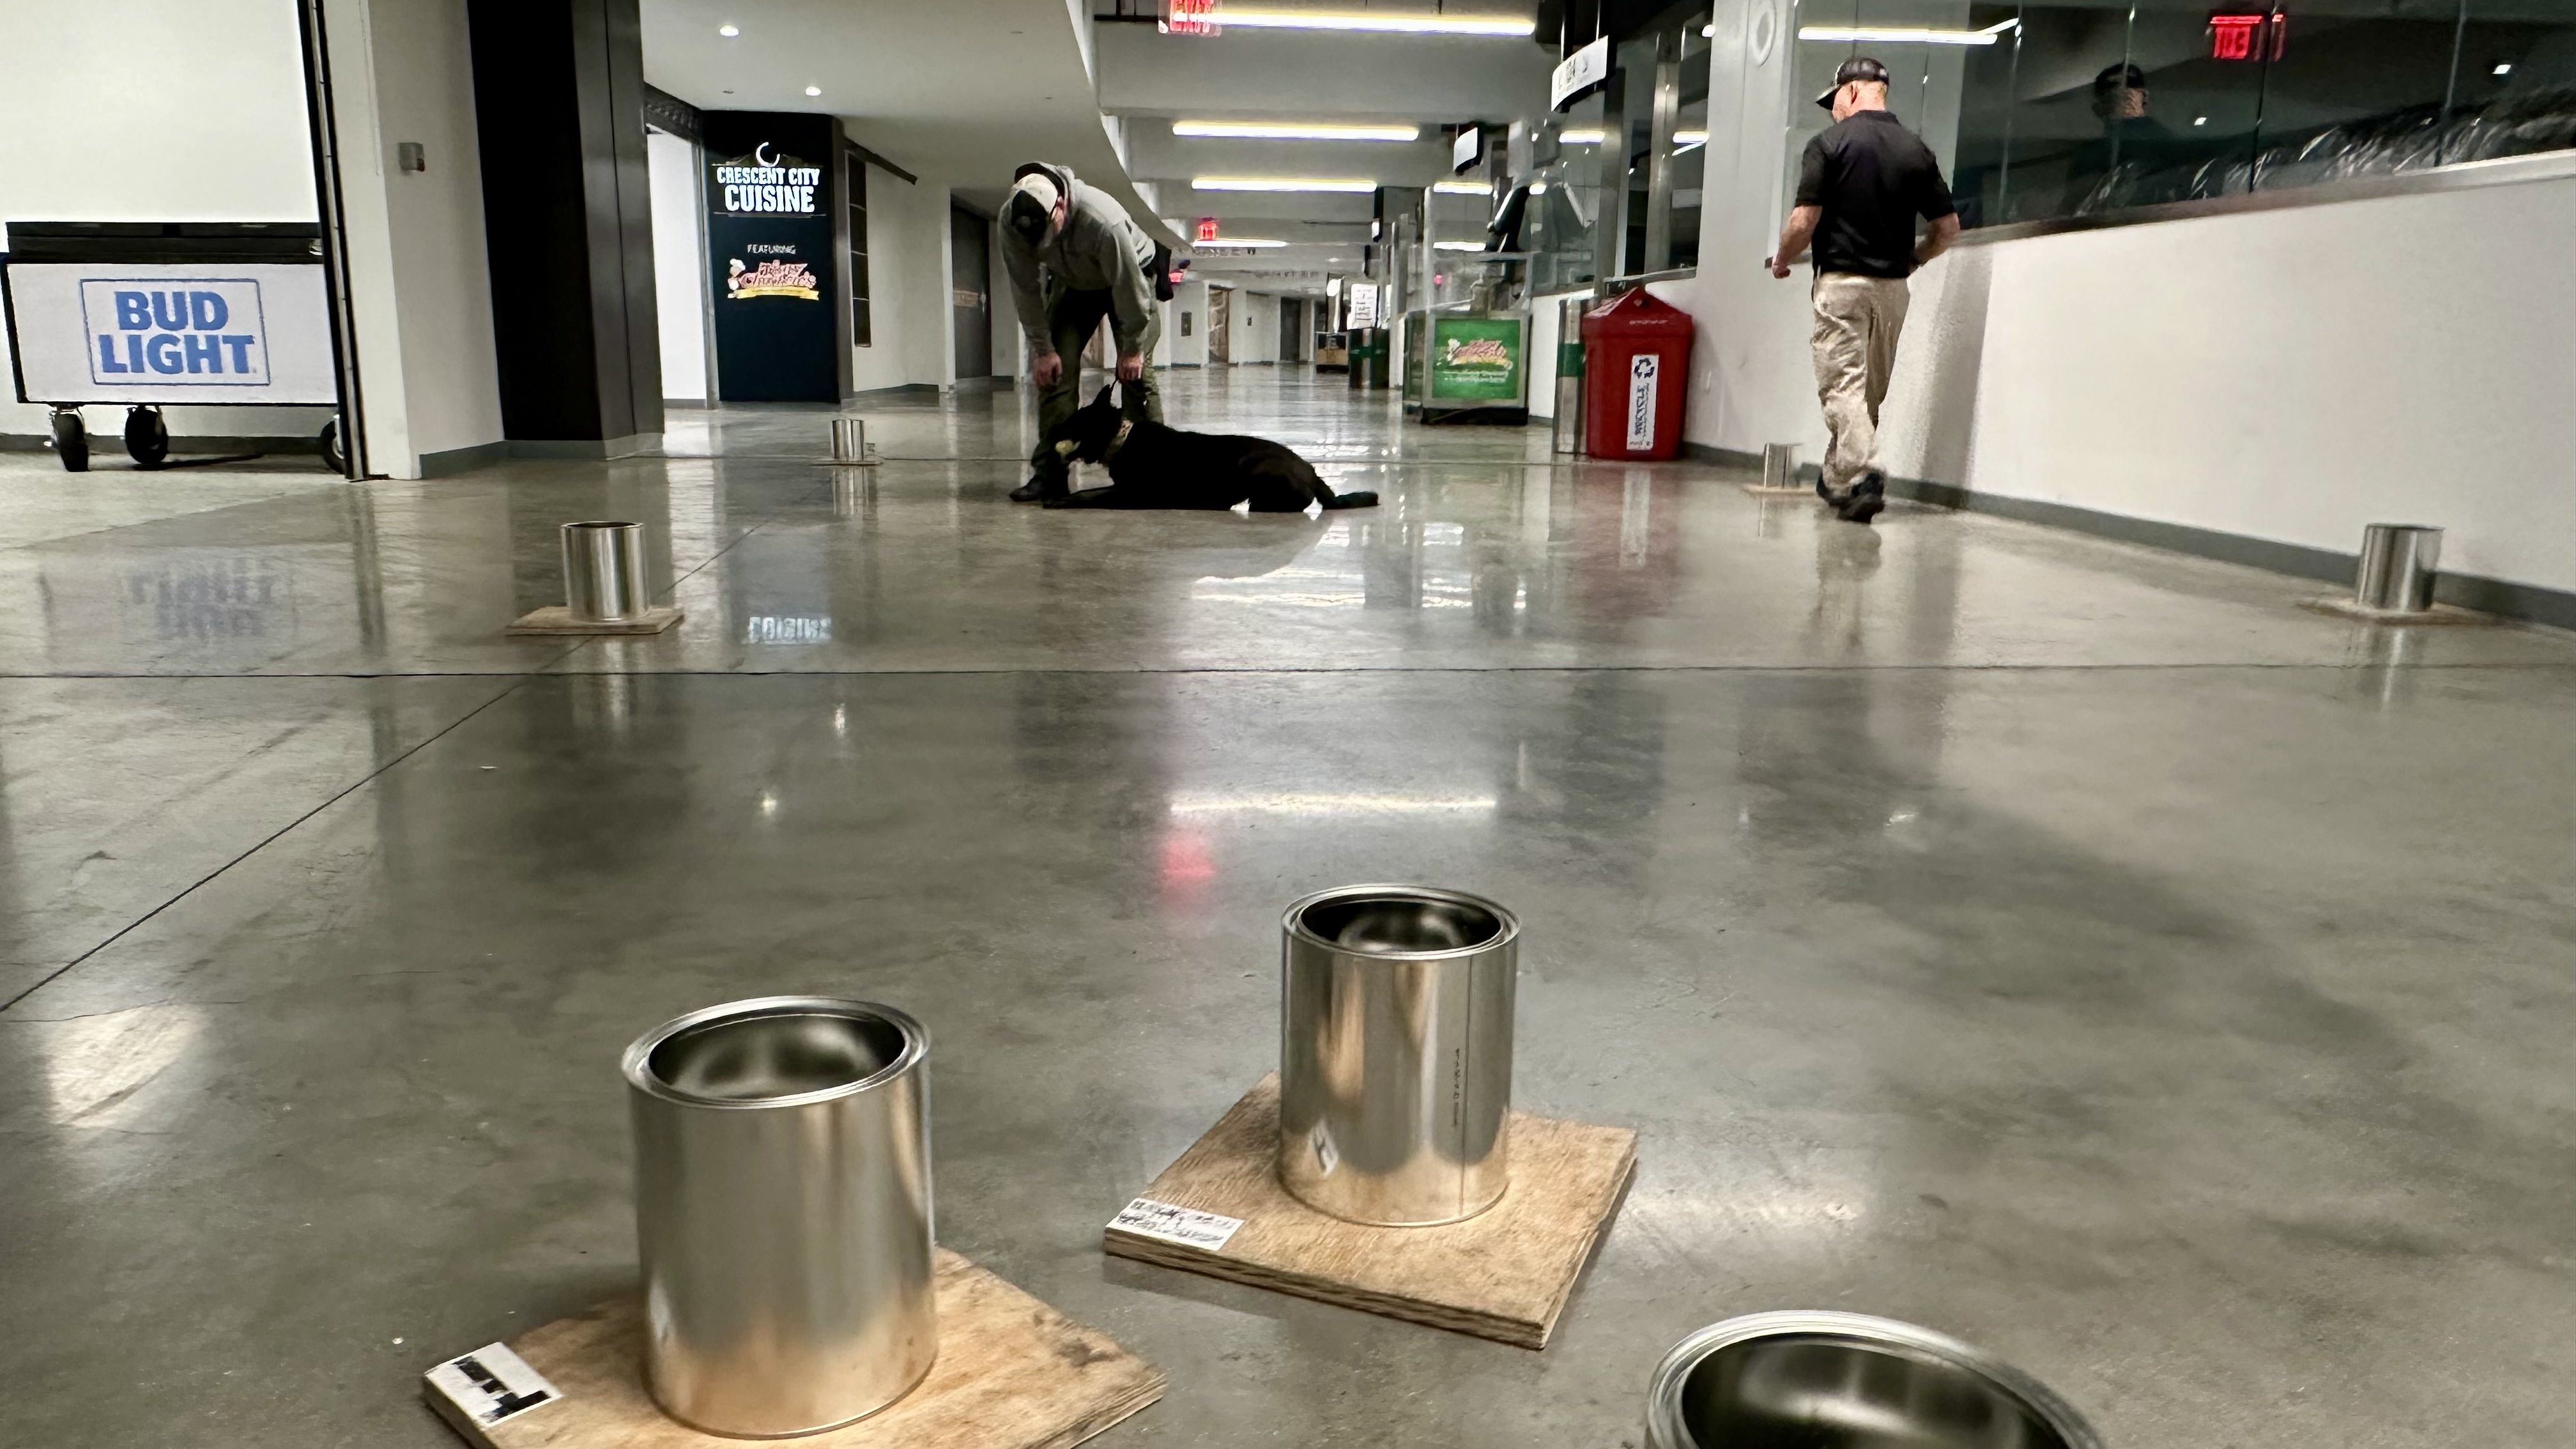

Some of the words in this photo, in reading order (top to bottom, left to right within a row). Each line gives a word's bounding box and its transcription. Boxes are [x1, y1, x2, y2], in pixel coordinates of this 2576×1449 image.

[716, 167, 786, 185] CRESCENT
[788, 167, 820, 185] CITY
[724, 184, 815, 213] CUISINE
[114, 291, 229, 332] BUD
[98, 334, 255, 374] LIGHT
